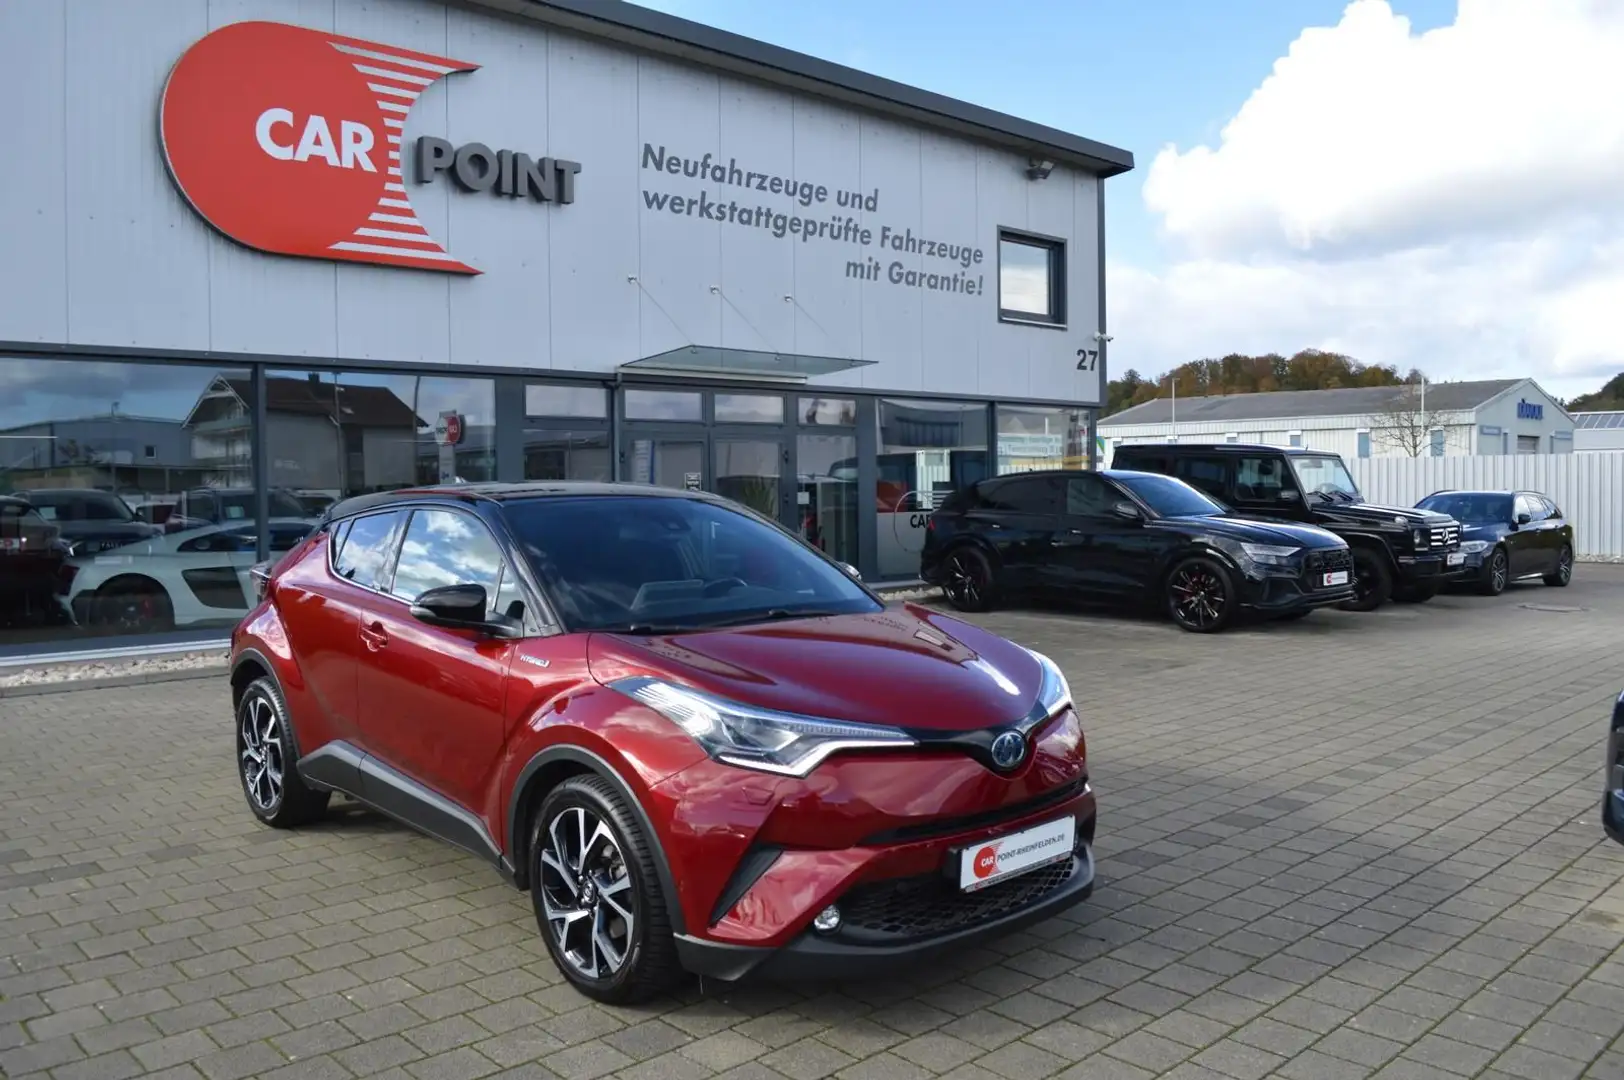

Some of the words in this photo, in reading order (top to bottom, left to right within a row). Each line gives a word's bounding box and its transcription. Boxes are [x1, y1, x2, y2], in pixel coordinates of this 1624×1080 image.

[255, 108, 377, 173] CAR
[415, 136, 582, 205] POINT
[642, 143, 828, 207] Neufahrzeuge
[836, 188, 879, 212] und
[642, 190, 872, 245] werkstattgeprüfte
[880, 225, 983, 268] Fahrzeuge
[845, 256, 881, 281] mit
[888, 261, 983, 295] Garantie!
[1076, 348, 1098, 371] 27
[981, 855, 994, 868] CAR
